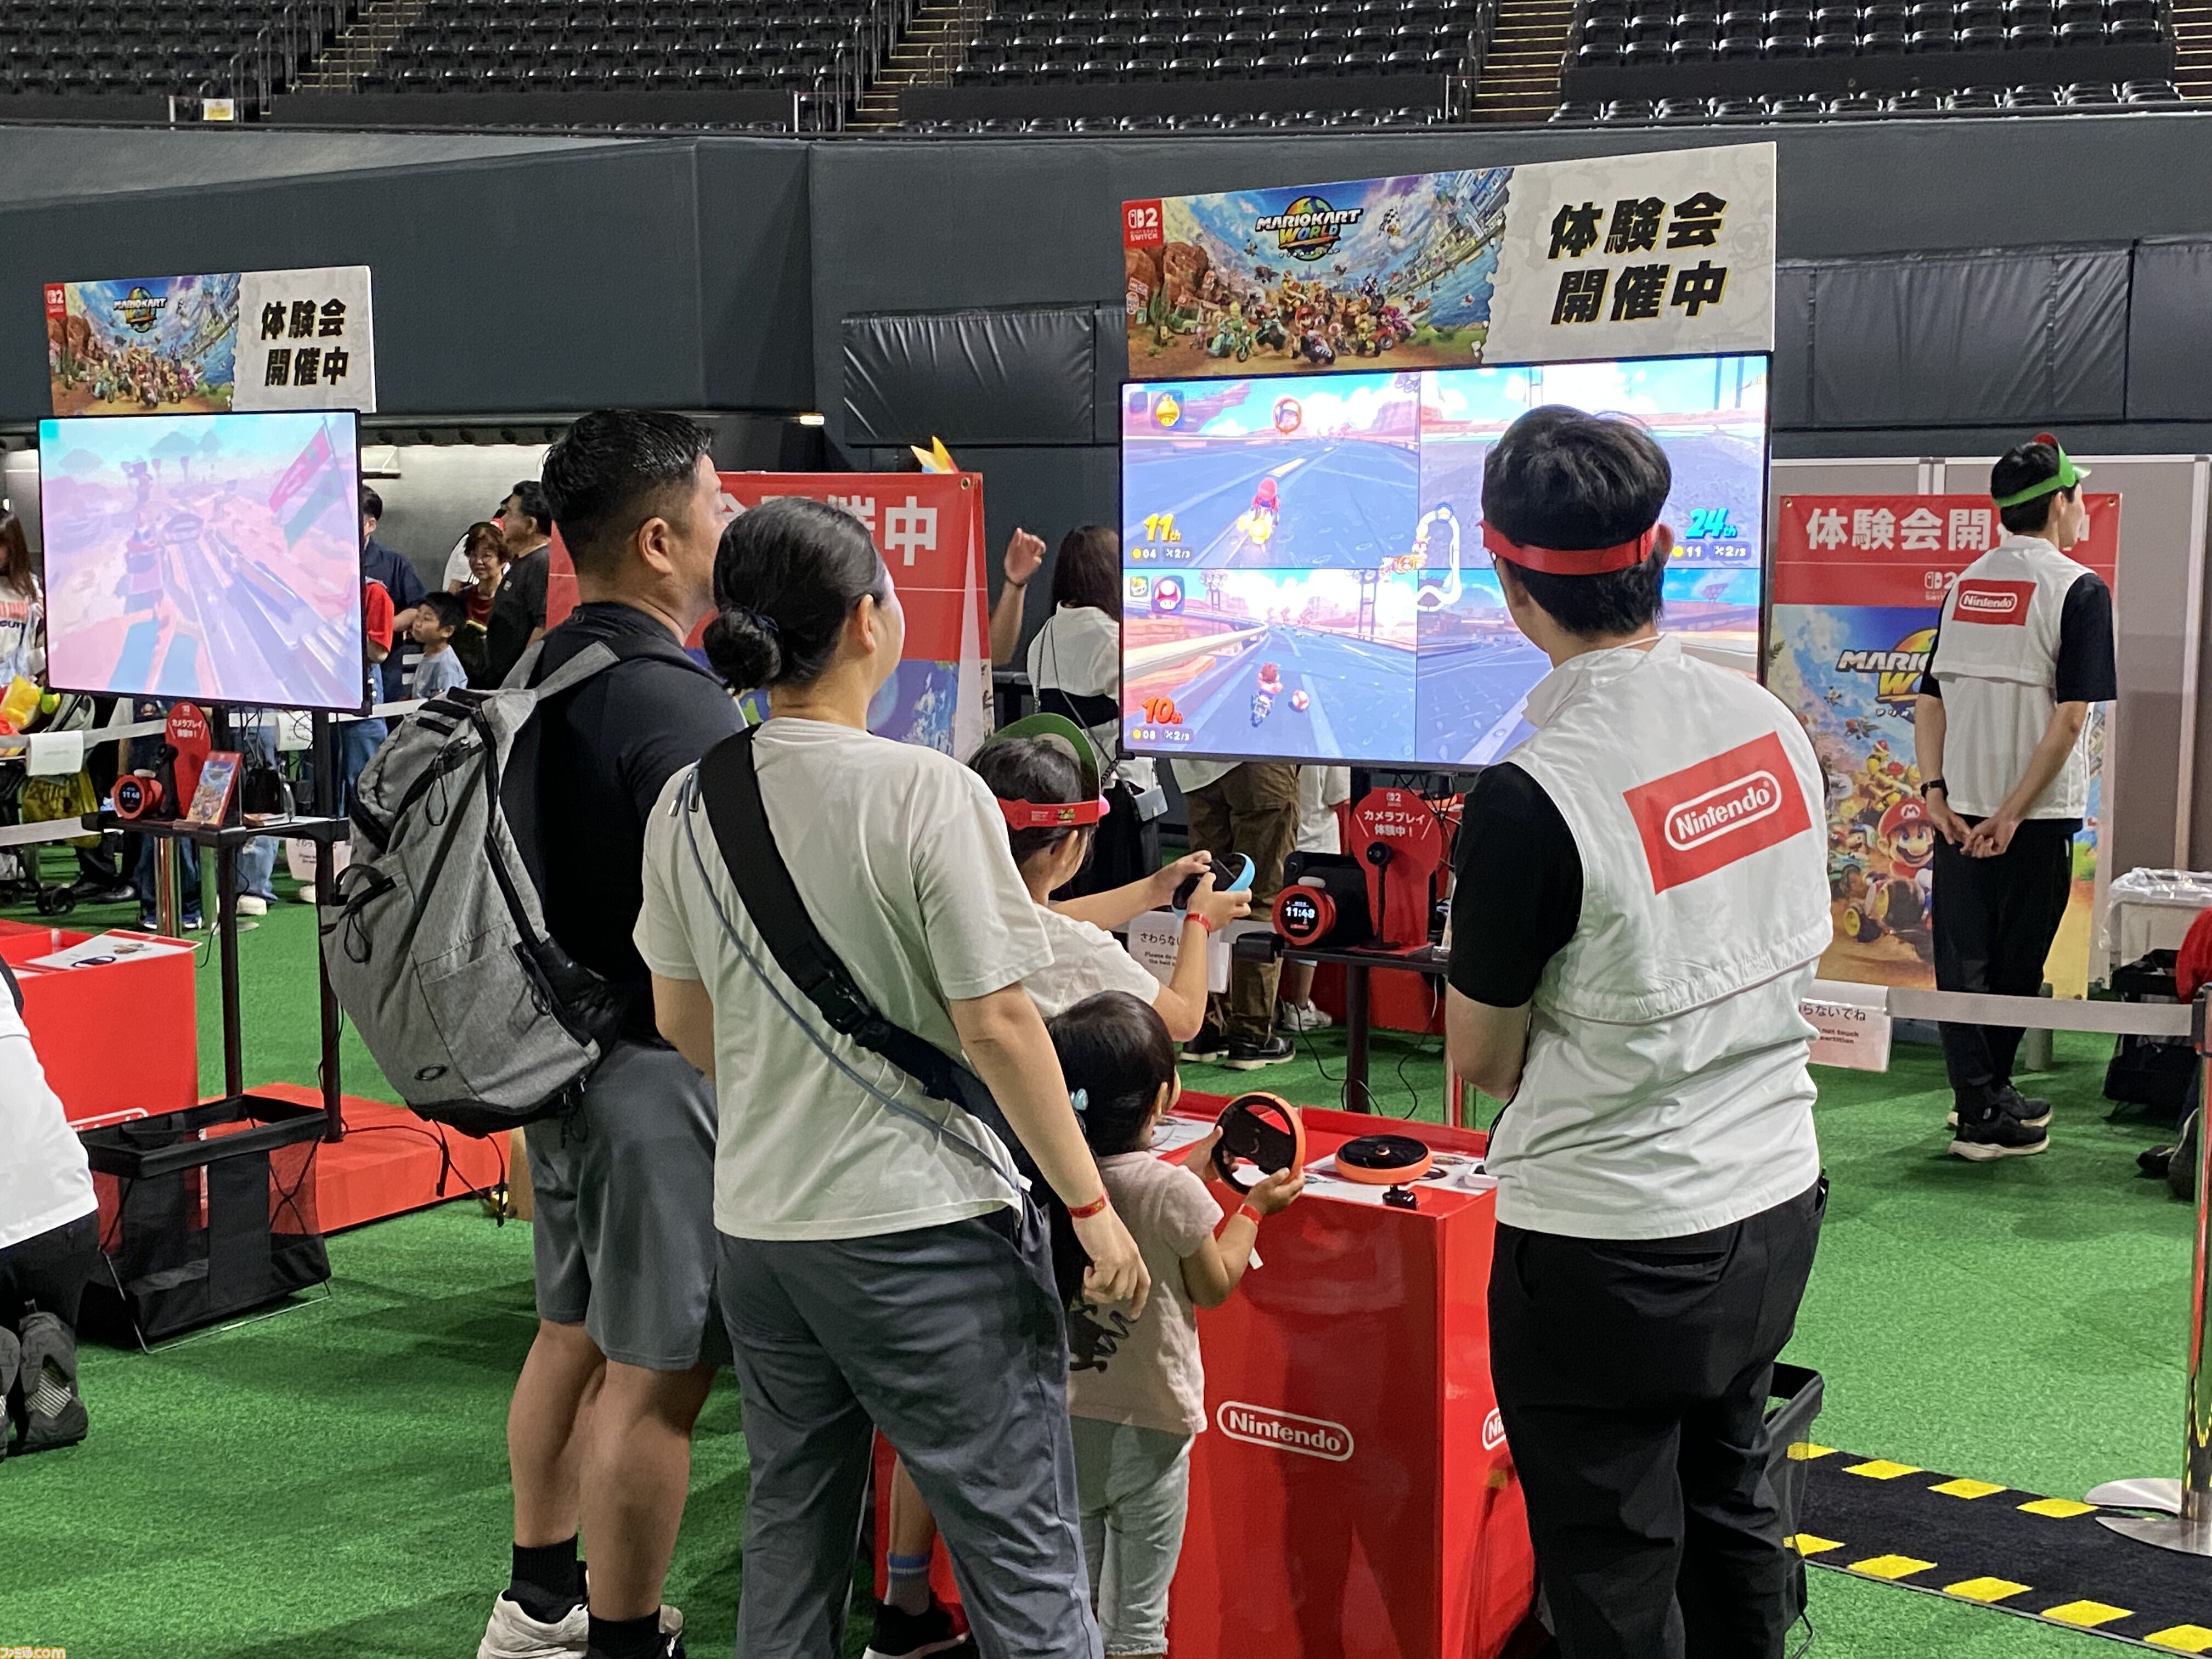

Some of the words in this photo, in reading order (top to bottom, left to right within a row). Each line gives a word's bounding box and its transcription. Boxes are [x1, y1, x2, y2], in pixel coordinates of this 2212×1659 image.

[1130, 232, 1158, 241] SWITCH
[1279, 224, 1339, 245] WORLD
[1548, 192, 1729, 259] 体験会
[1550, 260, 1728, 325] 開催中
[261, 298, 346, 340] 体験会
[264, 346, 349, 386] 開催中
[1685, 506, 1737, 539] 24th
[1806, 508, 2090, 551] 体験会開
[1143, 549, 1156, 558] 04
[1686, 546, 1701, 557] 11
[1963, 595, 2012, 608] Nintendo
[1364, 810, 1425, 825] カメラプレイ
[1675, 785, 1771, 841] Nintendo
[1286, 906, 1315, 919] 11:48
[1229, 1410, 1341, 1452] Nintendo
